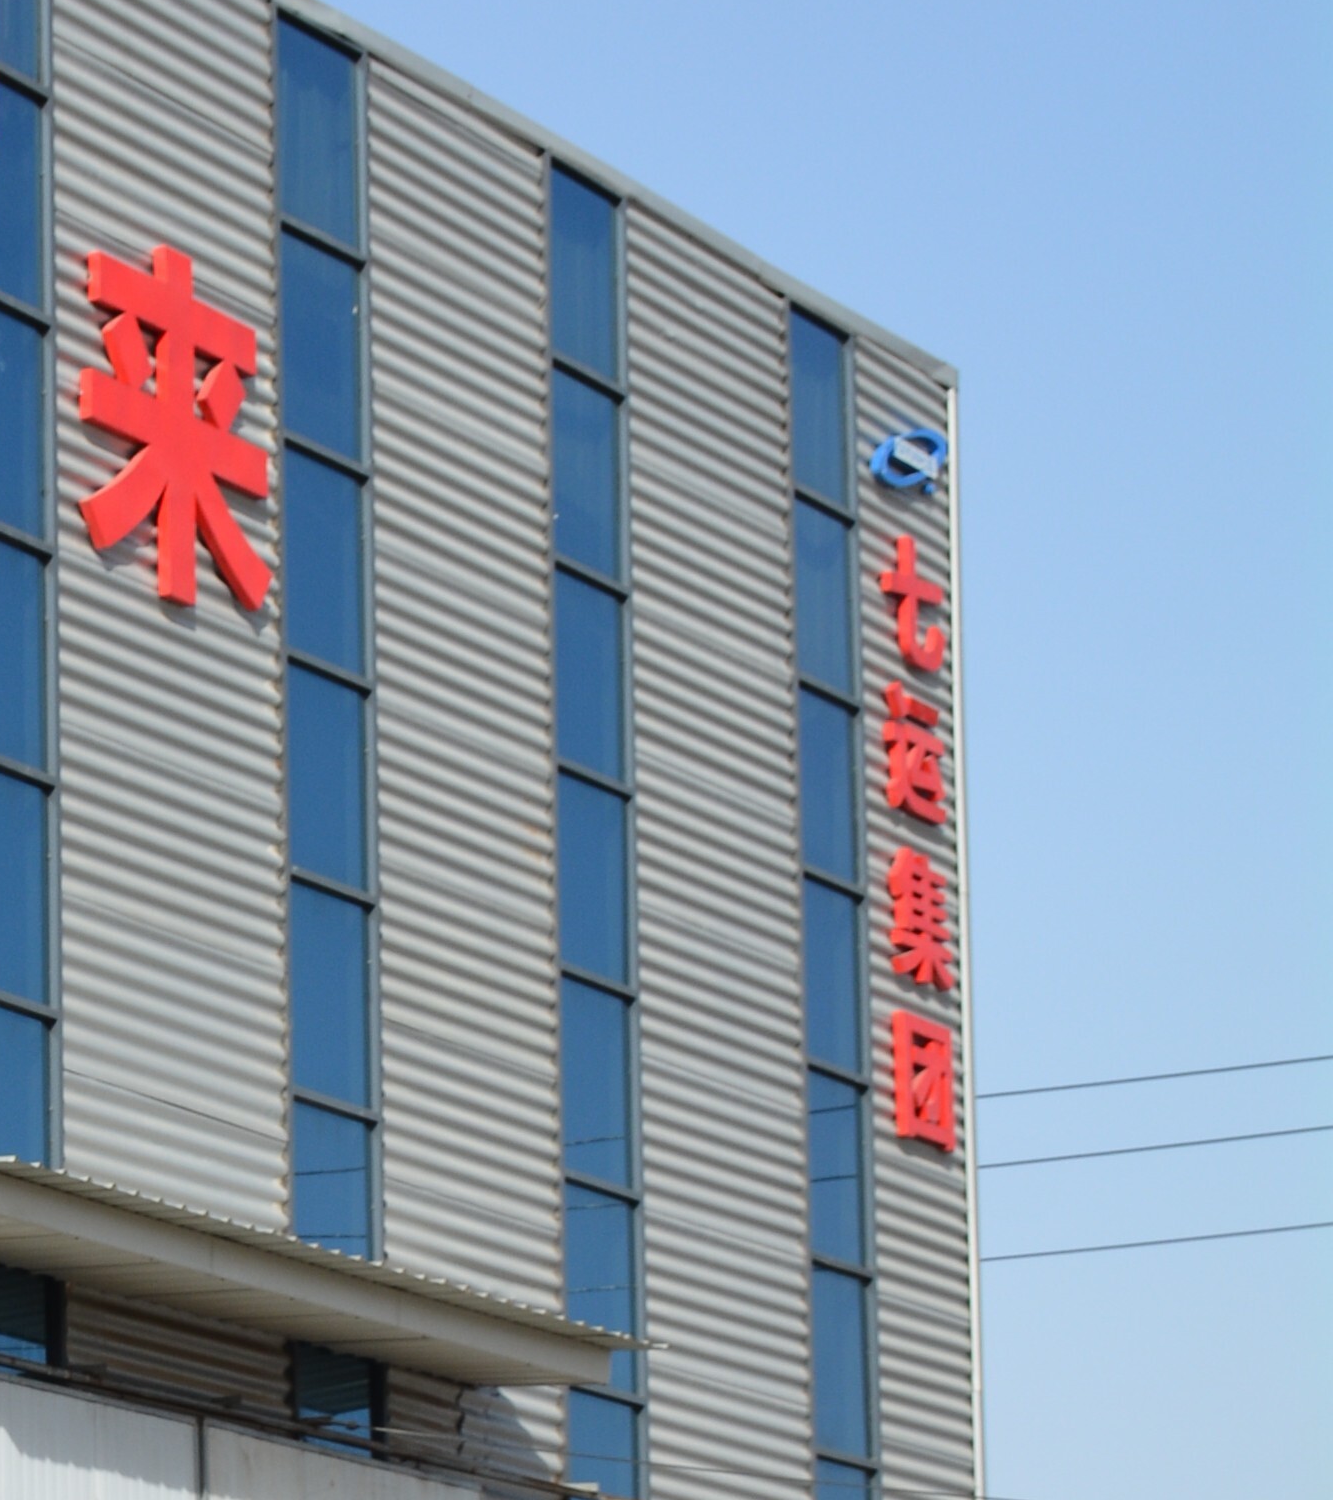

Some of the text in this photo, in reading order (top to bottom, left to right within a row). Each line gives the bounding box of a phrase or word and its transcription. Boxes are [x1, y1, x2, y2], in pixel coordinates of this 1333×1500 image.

[79, 244, 274, 612] 来
[879, 533, 956, 1153] 七运集团
